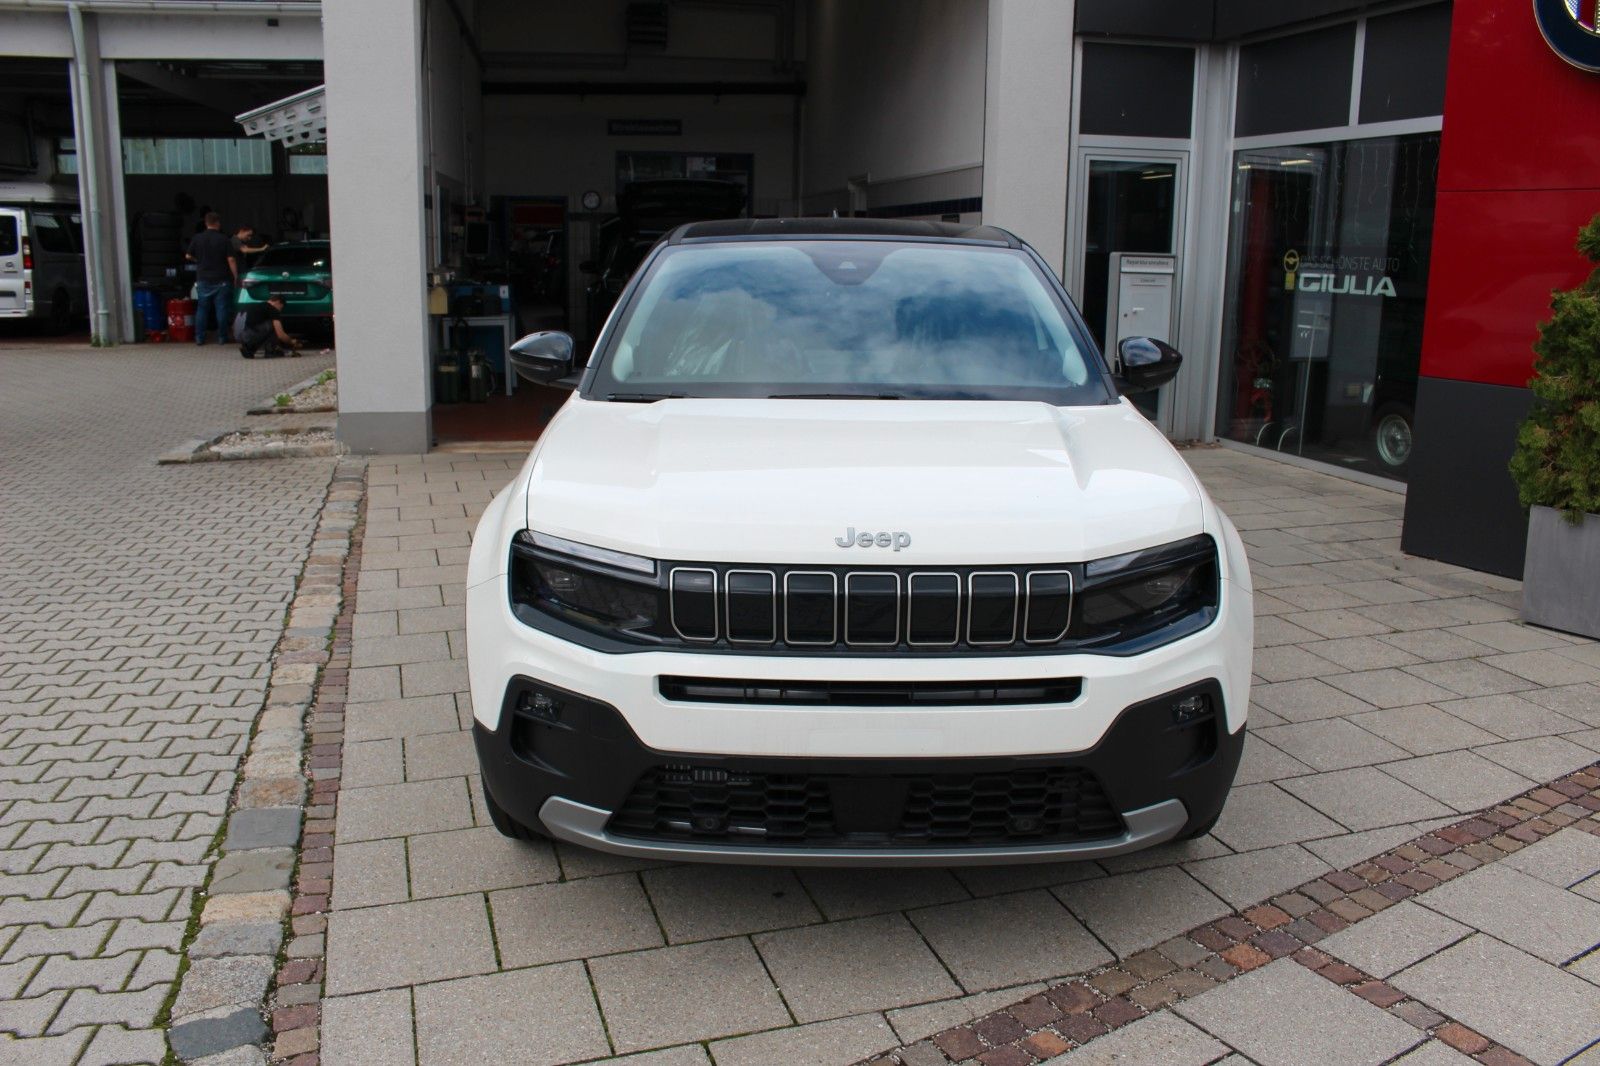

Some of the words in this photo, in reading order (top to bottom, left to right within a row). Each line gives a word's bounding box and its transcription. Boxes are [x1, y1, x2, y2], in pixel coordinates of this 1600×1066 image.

[1372, 256, 1400, 272] AUTO
[1298, 272, 1397, 297] GIULIA
[834, 526, 911, 552] Jeep
